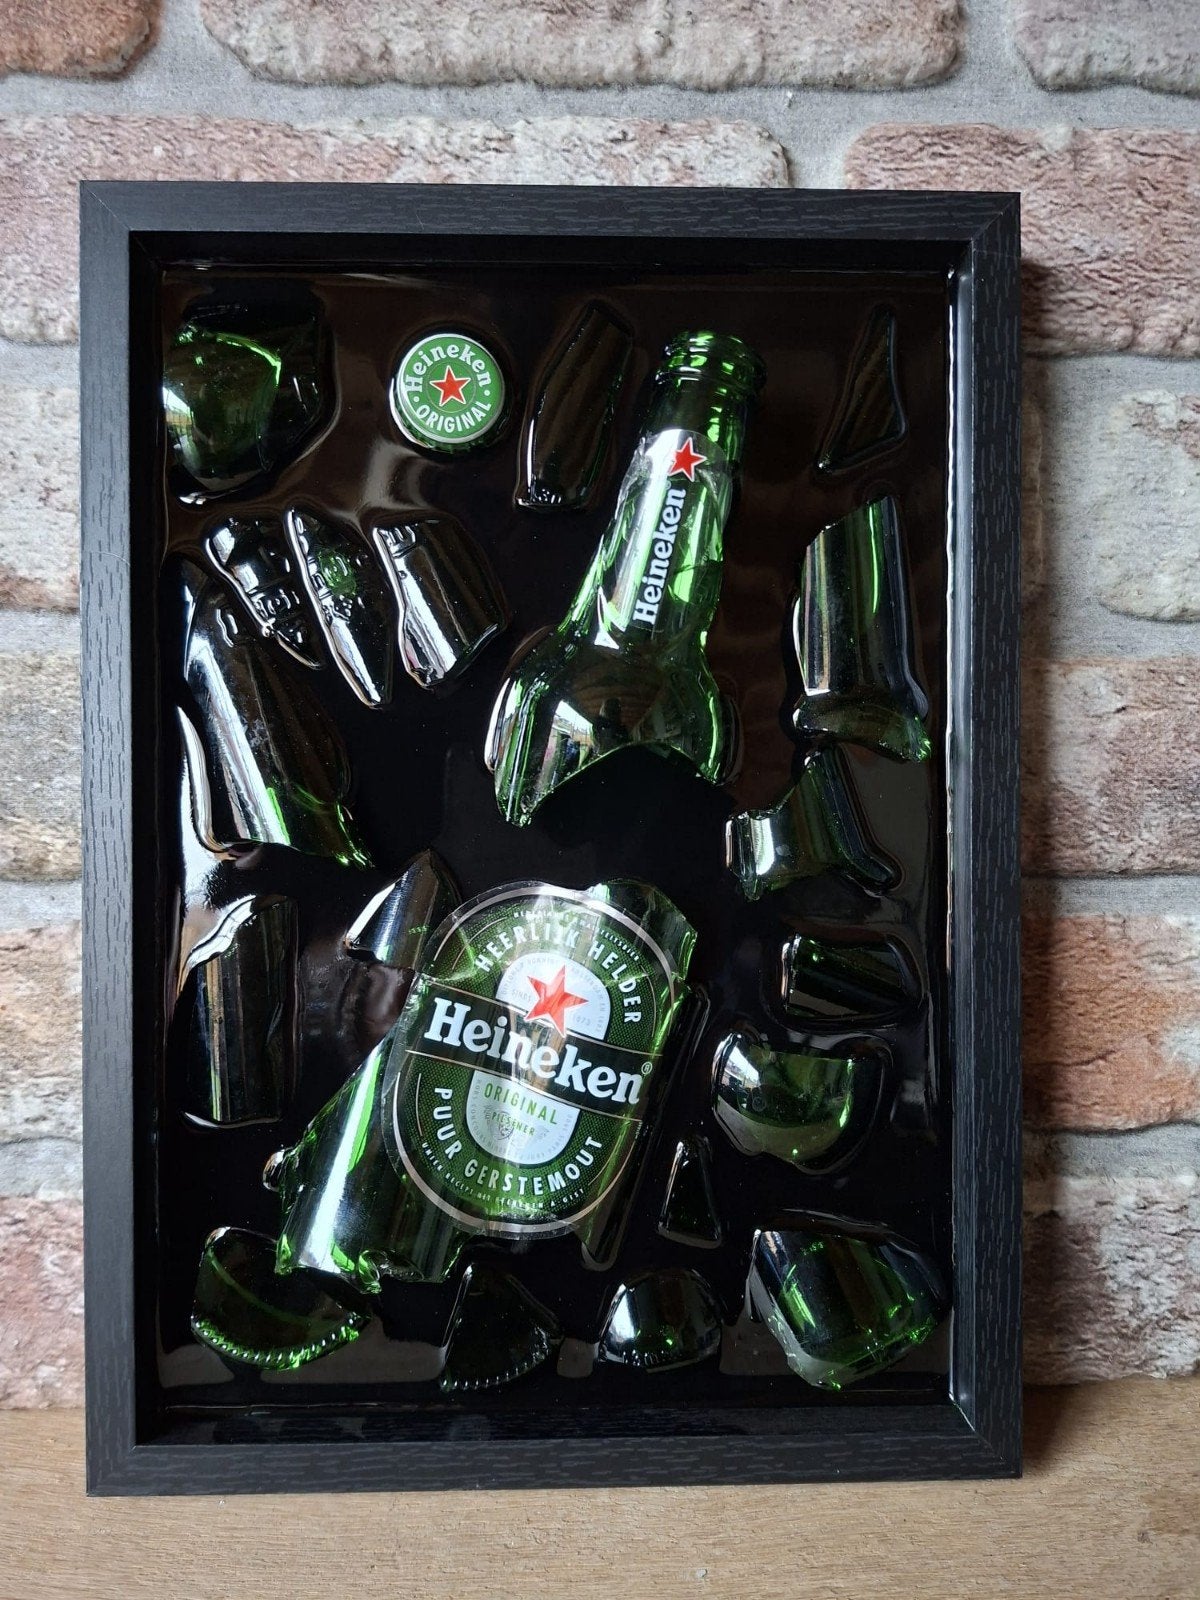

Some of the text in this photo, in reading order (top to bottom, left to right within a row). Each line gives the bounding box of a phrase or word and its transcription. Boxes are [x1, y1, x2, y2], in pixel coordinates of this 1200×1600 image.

[405, 344, 492, 393] Heineken
[416, 401, 492, 433] ORIGINAL
[632, 487, 687, 625] Heineken
[588, 940, 642, 1023] HELDER
[423, 997, 644, 1105] Heineken
[433, 1087, 462, 1160] PUUR
[464, 1136, 603, 1196] GERSTEMOUT
[483, 1083, 558, 1125] ORIGINAL
